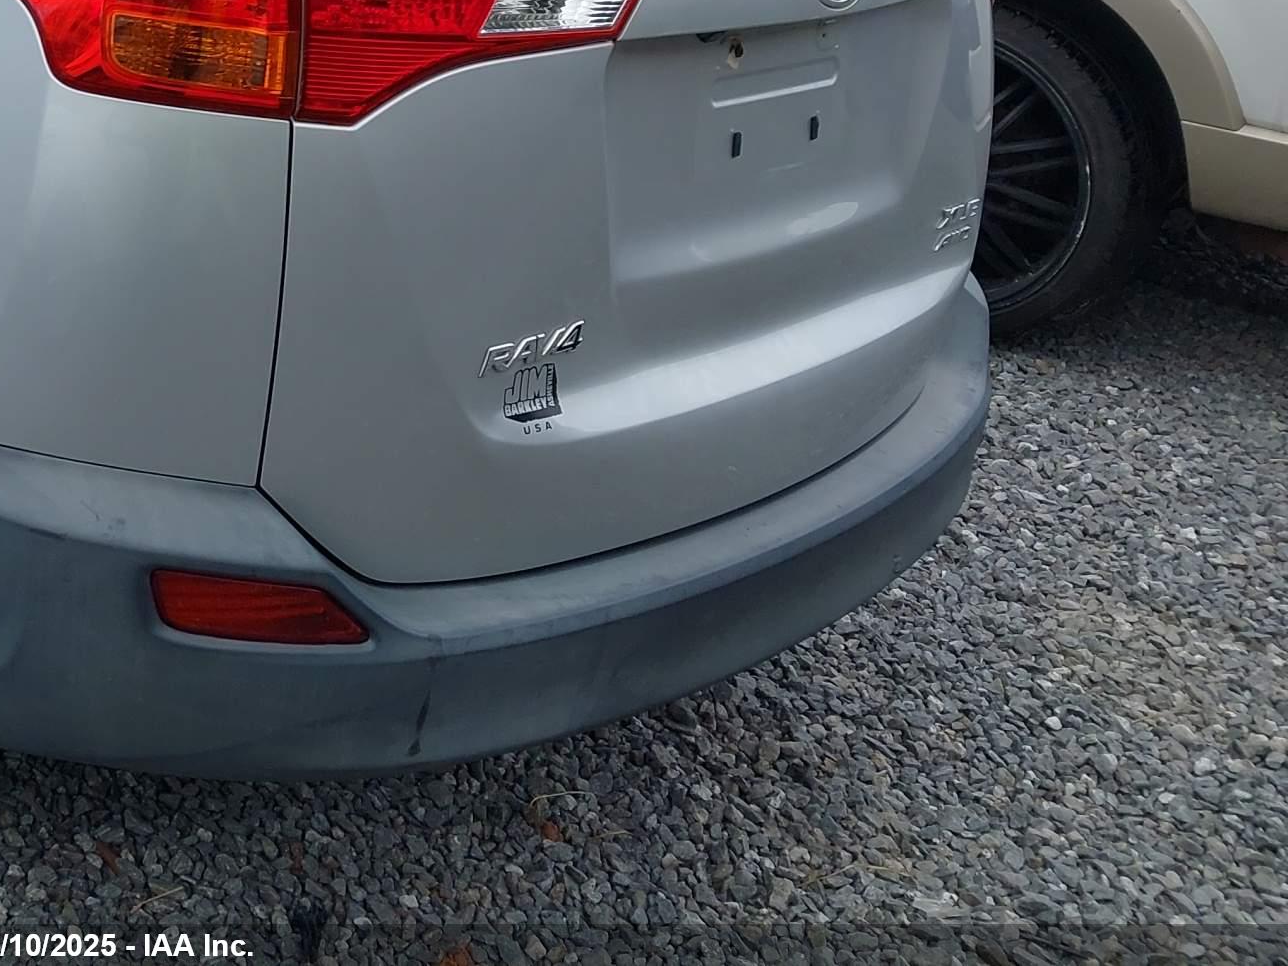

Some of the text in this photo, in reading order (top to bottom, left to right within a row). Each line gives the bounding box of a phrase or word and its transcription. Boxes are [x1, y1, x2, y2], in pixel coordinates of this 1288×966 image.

[477, 319, 584, 378] RAV4
[504, 363, 548, 405] JIM
[504, 397, 548, 417] BARKLEY
